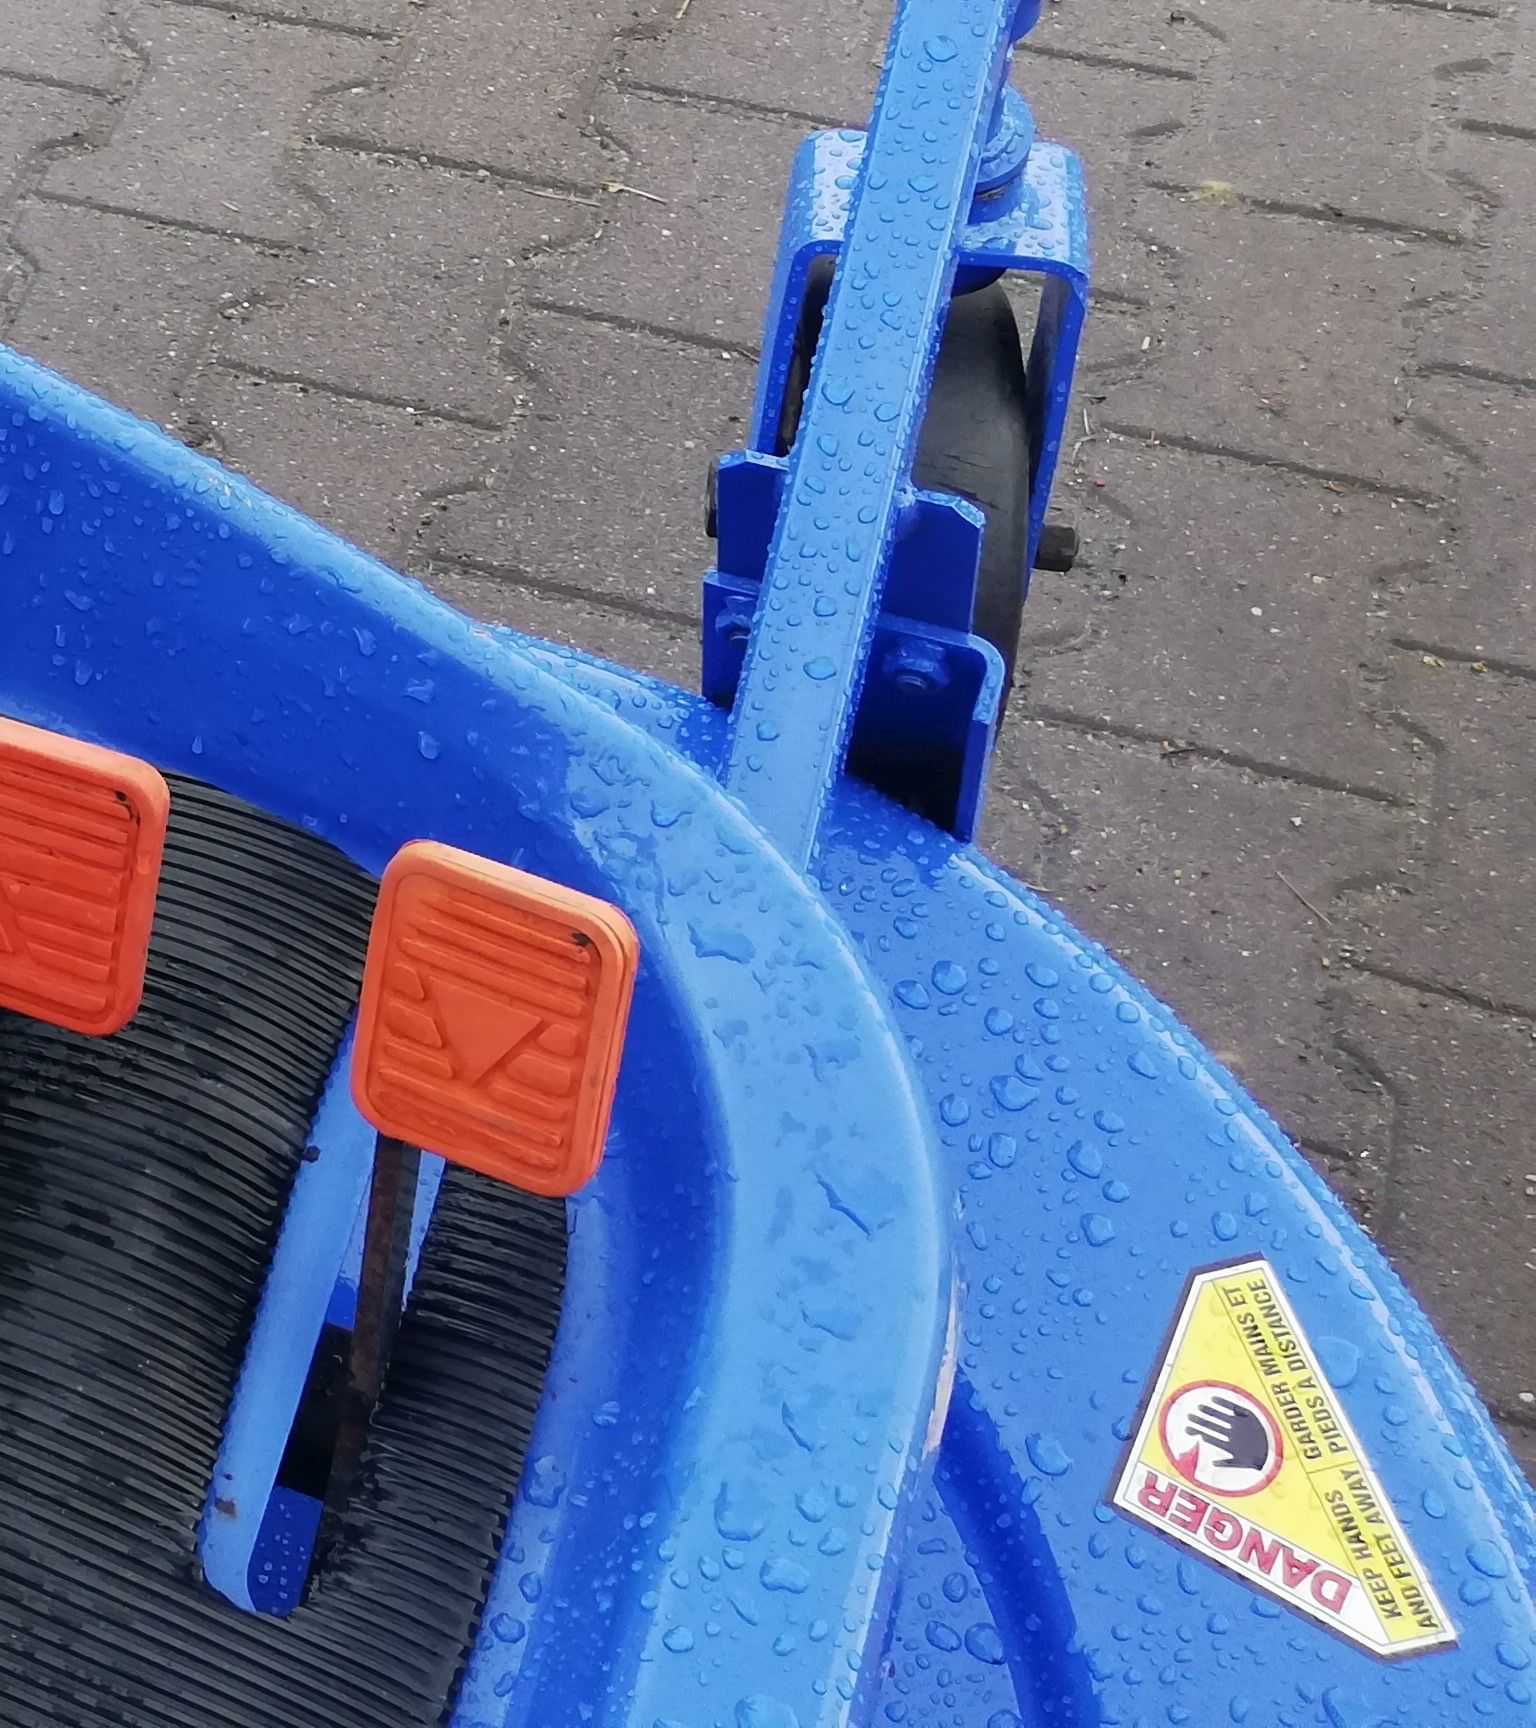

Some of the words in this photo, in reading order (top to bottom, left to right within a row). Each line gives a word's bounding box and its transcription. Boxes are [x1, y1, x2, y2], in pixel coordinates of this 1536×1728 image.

[1222, 1286, 1247, 1307] ET
[1247, 1278, 1308, 1372] DISTANCE
[1237, 1312, 1281, 1376] MAINS
[1271, 1380, 1322, 1460] GARDER
[1306, 1396, 1348, 1454] PIEDS
[1324, 1489, 1374, 1560] HANDS
[1340, 1469, 1385, 1525] AWAY
[1137, 1471, 1353, 1614] DANGER
[1373, 1533, 1412, 1580] FEET
[1362, 1568, 1403, 1618] KEEP
[1401, 1584, 1439, 1629] AND
